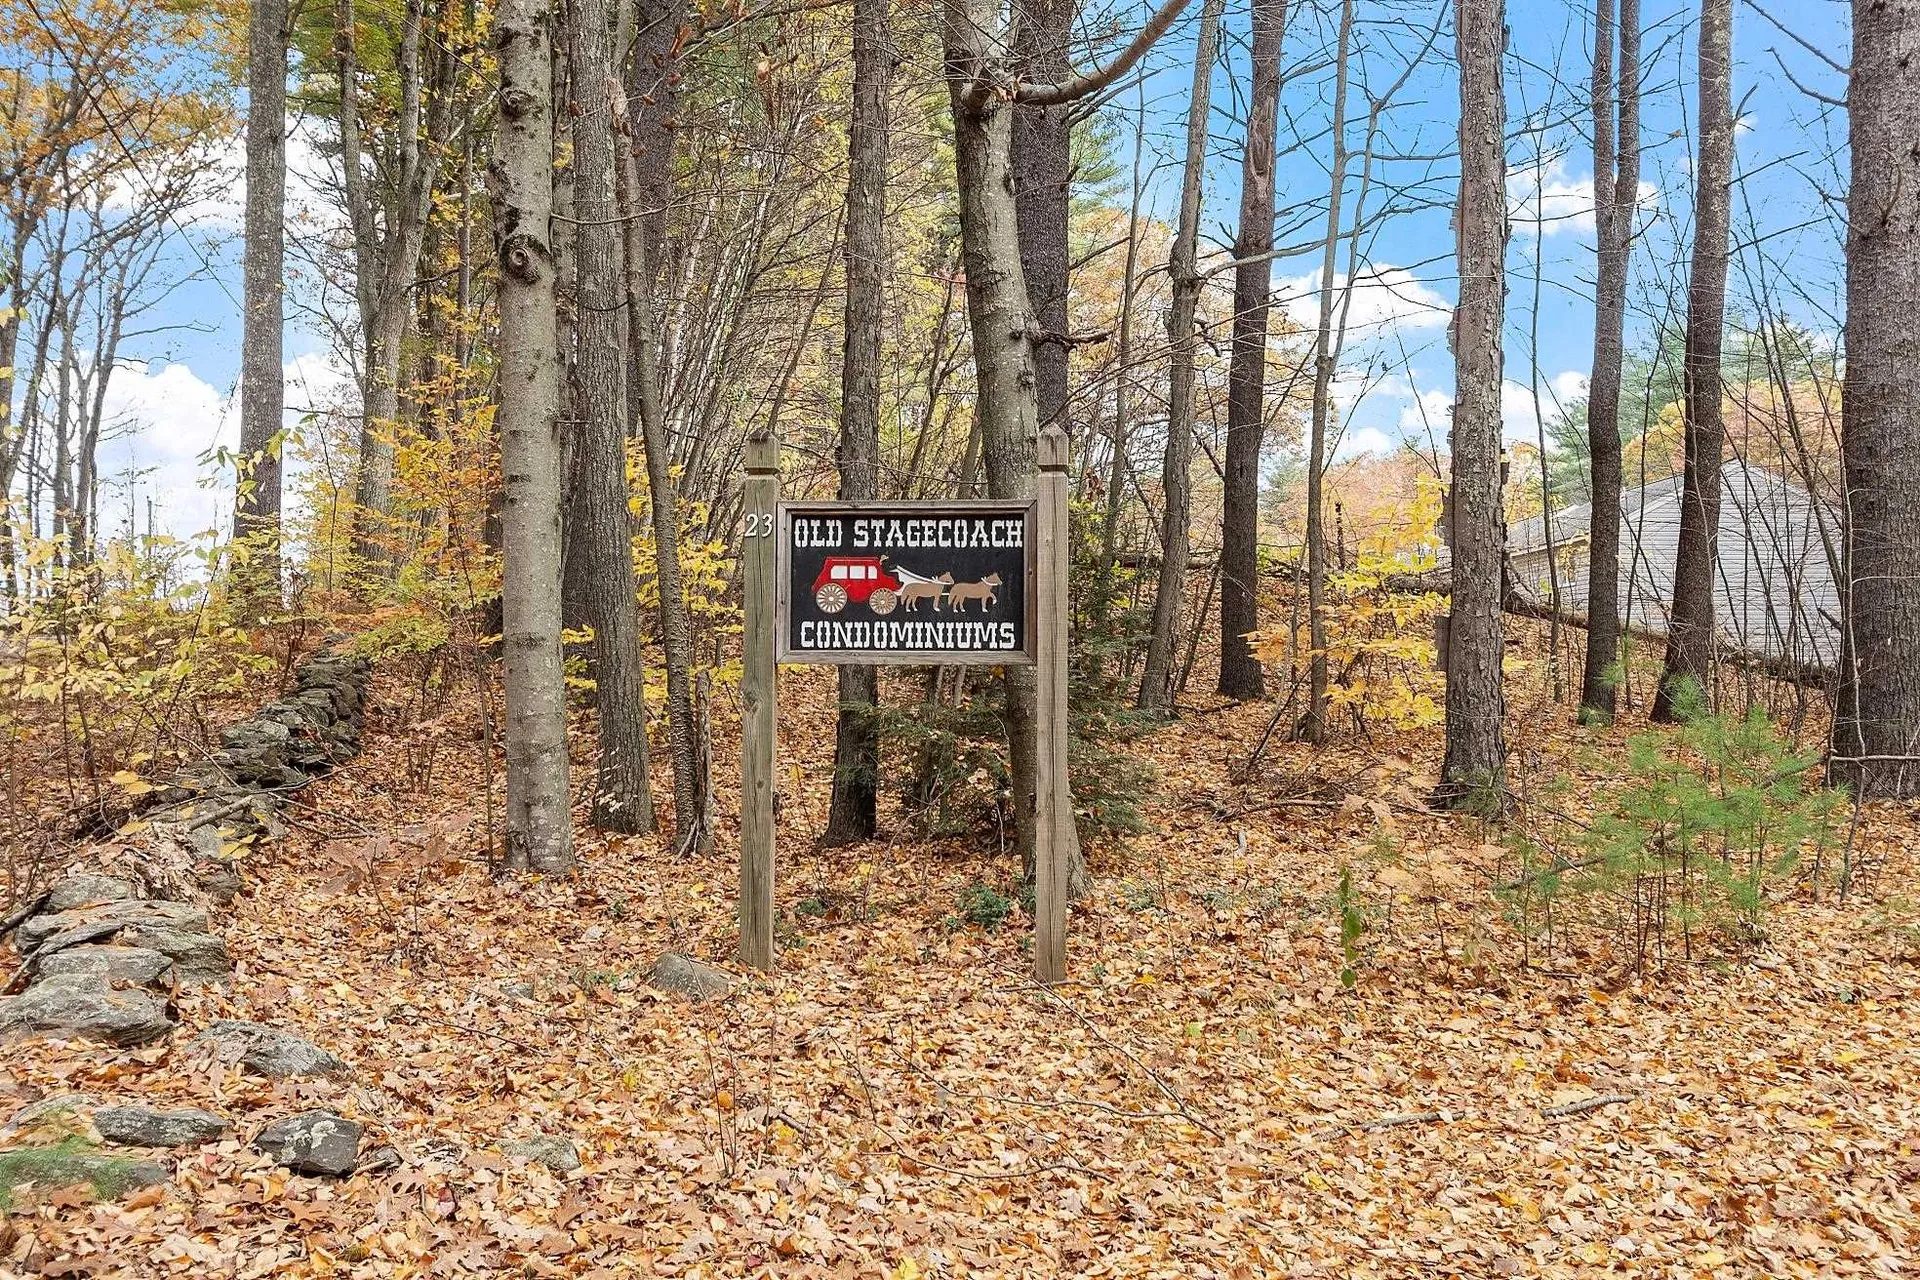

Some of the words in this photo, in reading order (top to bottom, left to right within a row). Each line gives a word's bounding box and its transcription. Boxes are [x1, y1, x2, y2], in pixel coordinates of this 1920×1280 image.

[744, 513, 774, 538] 23
[794, 518, 843, 548] OLD
[853, 518, 1023, 548] STAGECOACH
[800, 620, 1015, 649] CONDOMINIUMS
